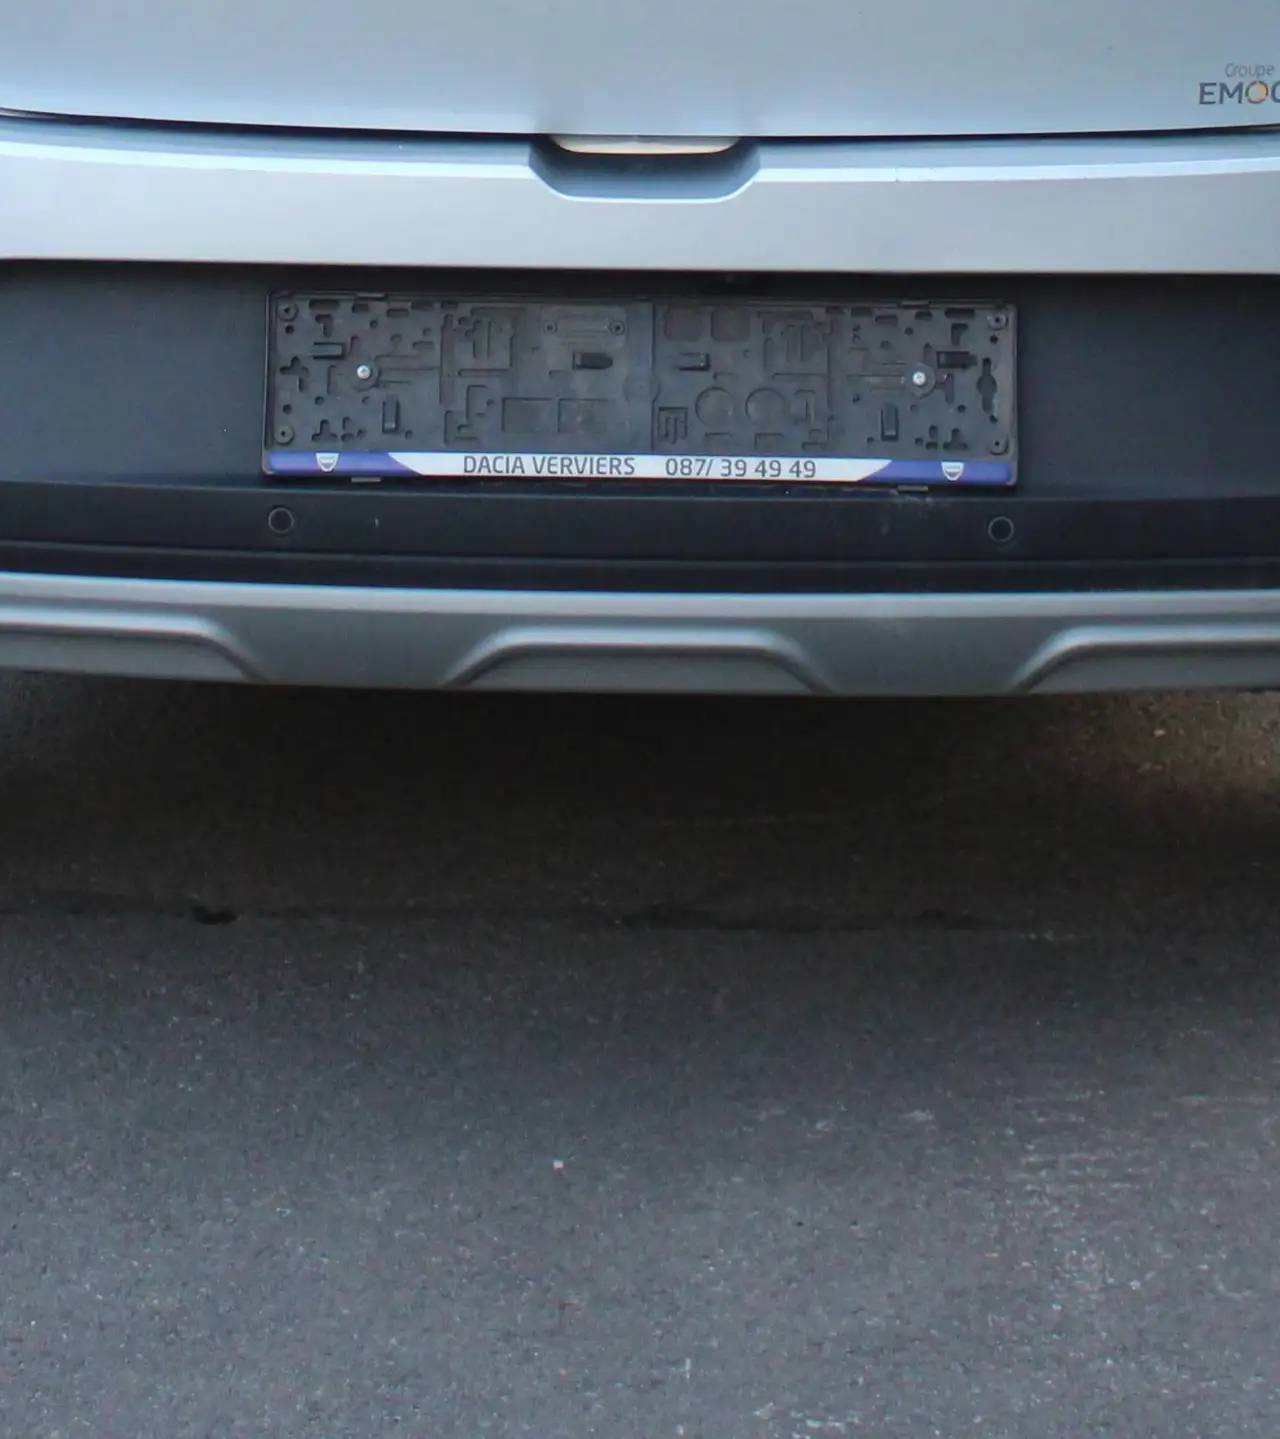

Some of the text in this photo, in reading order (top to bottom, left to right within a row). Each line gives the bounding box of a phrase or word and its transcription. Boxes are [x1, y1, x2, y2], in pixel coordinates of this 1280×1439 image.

[1224, 62, 1275, 79] Groupe
[463, 455, 817, 479] DACIA VERVIERS 087/ 39 49 49
